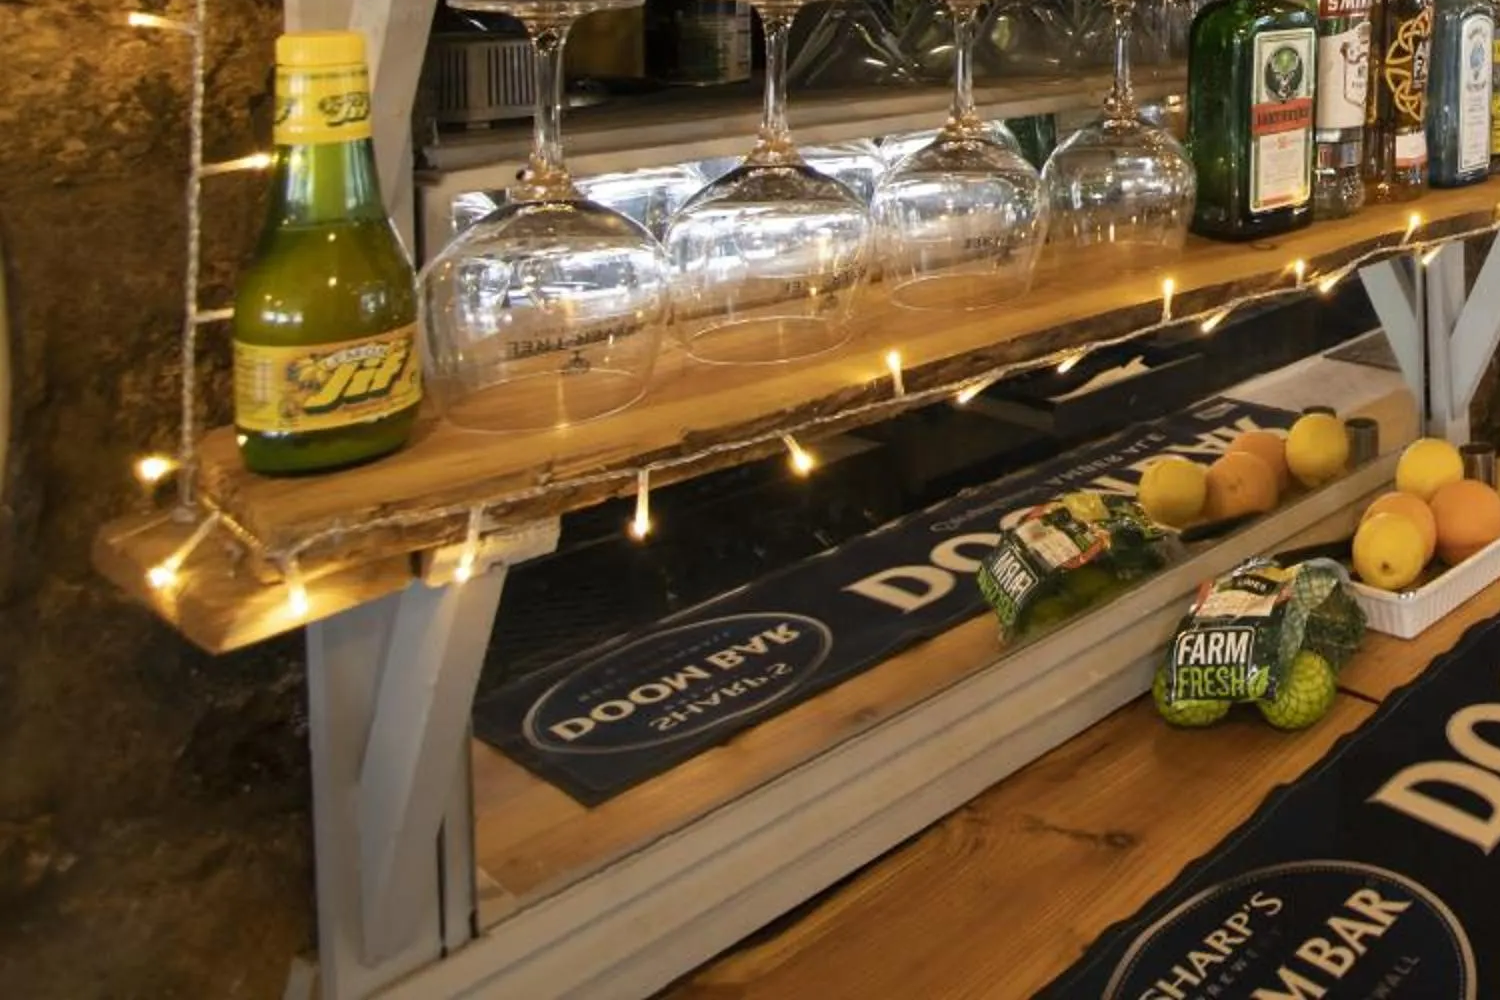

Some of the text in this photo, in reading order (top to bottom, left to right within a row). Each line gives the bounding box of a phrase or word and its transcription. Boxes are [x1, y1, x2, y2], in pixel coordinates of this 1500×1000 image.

[303, 338, 411, 414] Jif
[1176, 631, 1251, 665] FARM
[1176, 665, 1247, 699] FRESH
[1138, 890, 1283, 1000] SHARP'S
